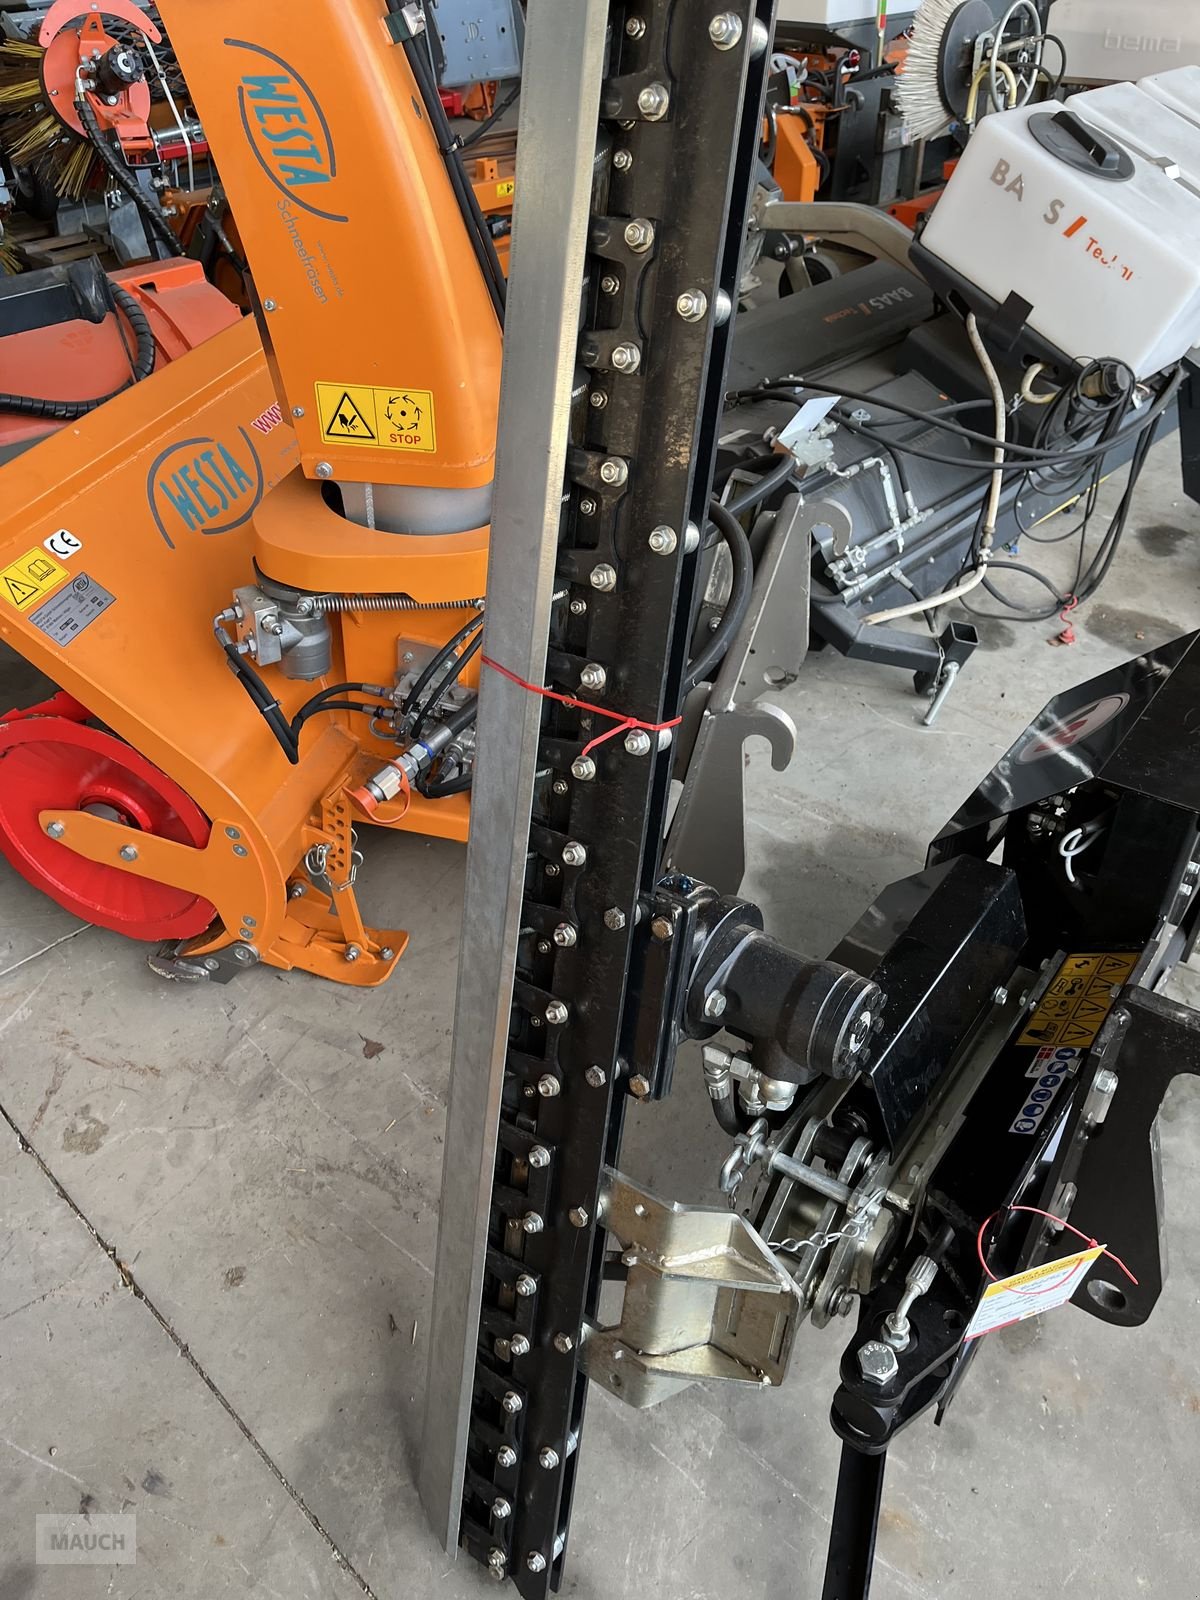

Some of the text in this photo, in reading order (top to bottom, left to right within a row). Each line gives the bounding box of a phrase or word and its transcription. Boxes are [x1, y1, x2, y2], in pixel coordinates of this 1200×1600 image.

[1103, 28, 1181, 53] bema
[241, 75, 331, 186] WESTA
[277, 198, 328, 304] Schneefräsen
[869, 286, 914, 310] BAAS
[389, 433, 421, 445] STOP
[159, 442, 253, 531] WESTA
[50, 531, 80, 555] CE
